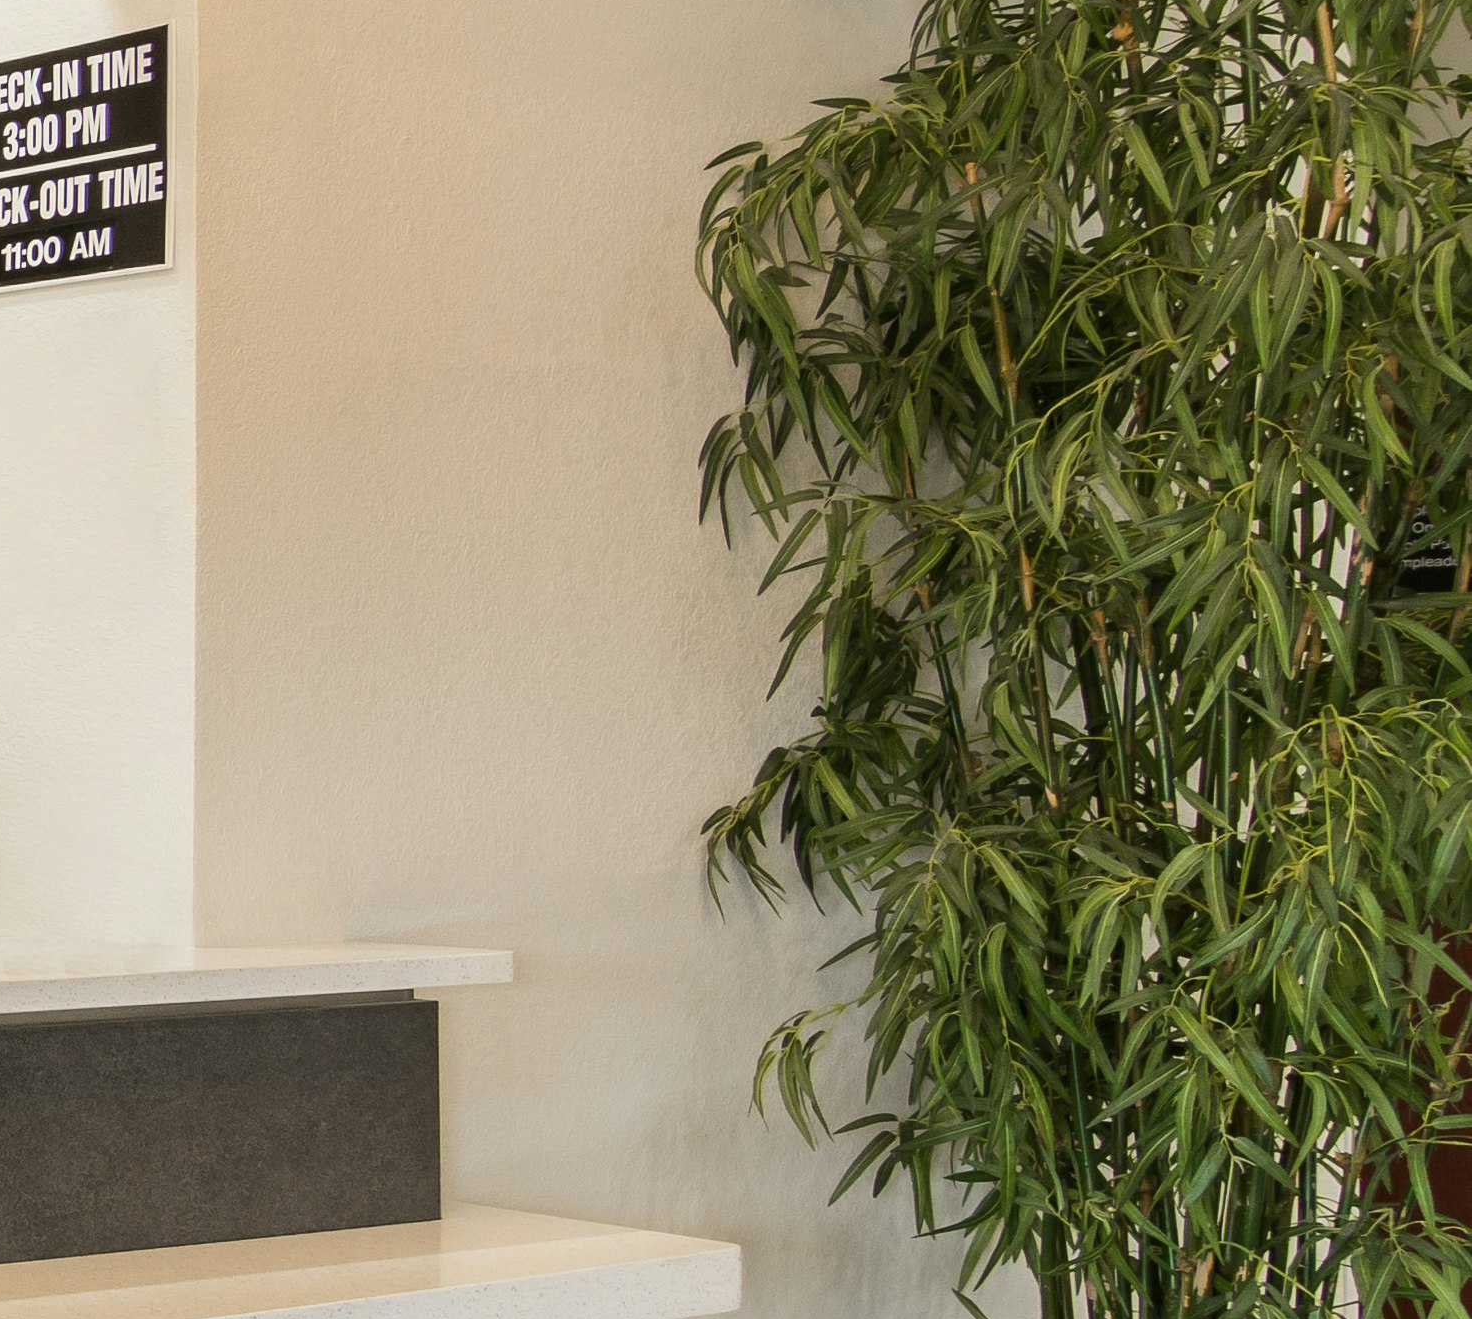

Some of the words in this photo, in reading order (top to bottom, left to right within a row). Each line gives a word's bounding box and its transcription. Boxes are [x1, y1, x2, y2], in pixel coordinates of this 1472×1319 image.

[87, 42, 154, 94] TIME
[2, 113, 61, 161] 3:00
[65, 103, 109, 149] PM
[98, 161, 165, 210] TIME
[1, 235, 62, 272] 11:00
[69, 226, 113, 261] AM
